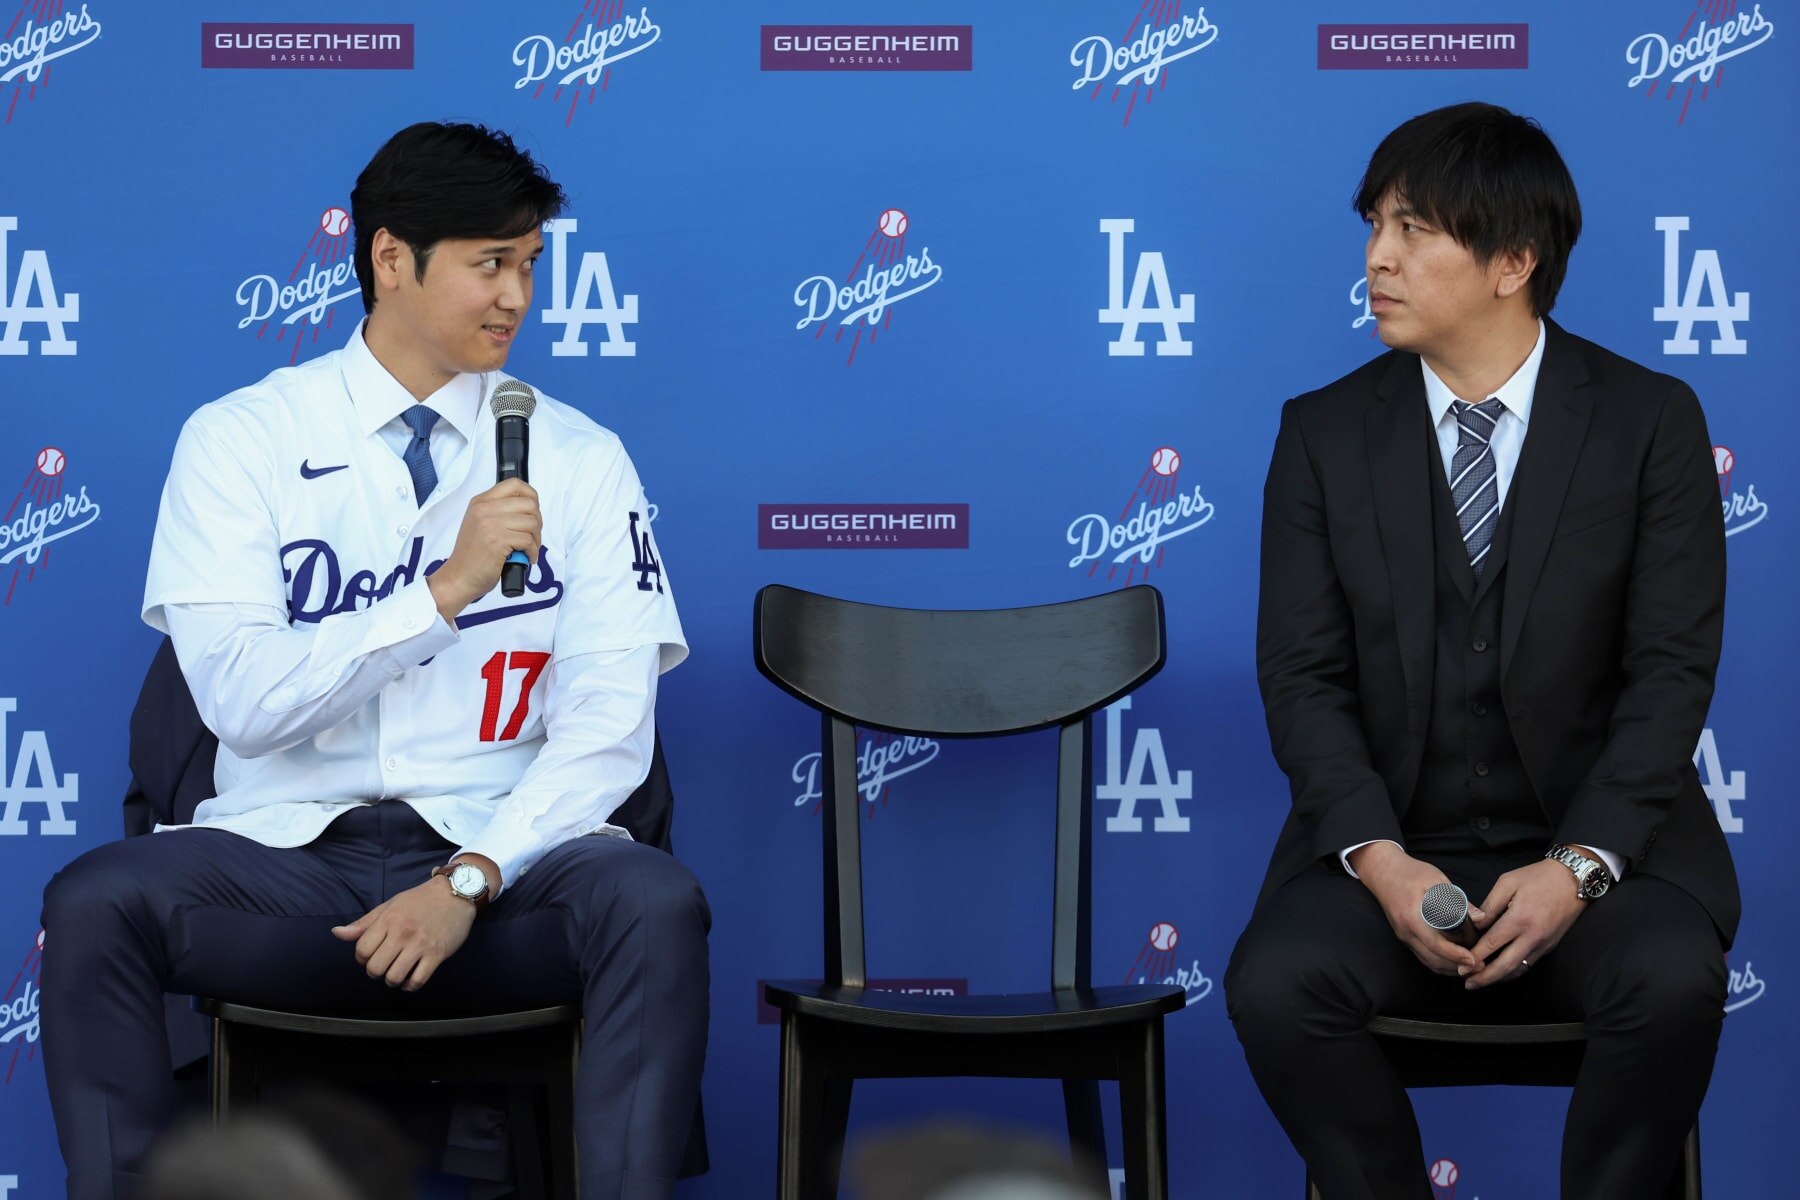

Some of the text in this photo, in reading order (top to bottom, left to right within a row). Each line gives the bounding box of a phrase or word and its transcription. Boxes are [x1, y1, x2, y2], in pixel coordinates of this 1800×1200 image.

[0, 3, 101, 82] odgers
[215, 33, 401, 50] GUGGENHEIM
[271, 54, 342, 62] BASEBALL
[513, 6, 661, 89] Dodgers
[774, 35, 959, 52] GUGGENHEIM
[829, 56, 900, 64] BASEBALL
[1070, 6, 1219, 90] Dodgers
[1330, 34, 1516, 50] GUGGENHEIM
[1386, 55, 1458, 63] BASEBALL
[1626, 4, 1774, 88] Dodgers
[235, 254, 362, 329] Dodger
[541, 218, 639, 357] LA
[794, 247, 942, 330] Dodgers
[1099, 218, 1195, 356] LA
[1653, 216, 1750, 355] LA
[0, 485, 100, 564] odgers
[628, 511, 664, 595] LA
[771, 514, 956, 530] GUGGENHEIM
[827, 534, 898, 542] BASEBALL
[1066, 485, 1215, 568] Dodgers
[479, 650, 551, 742] 17
[792, 736, 940, 806] Ddgers
[1096, 695, 1192, 832] LA
